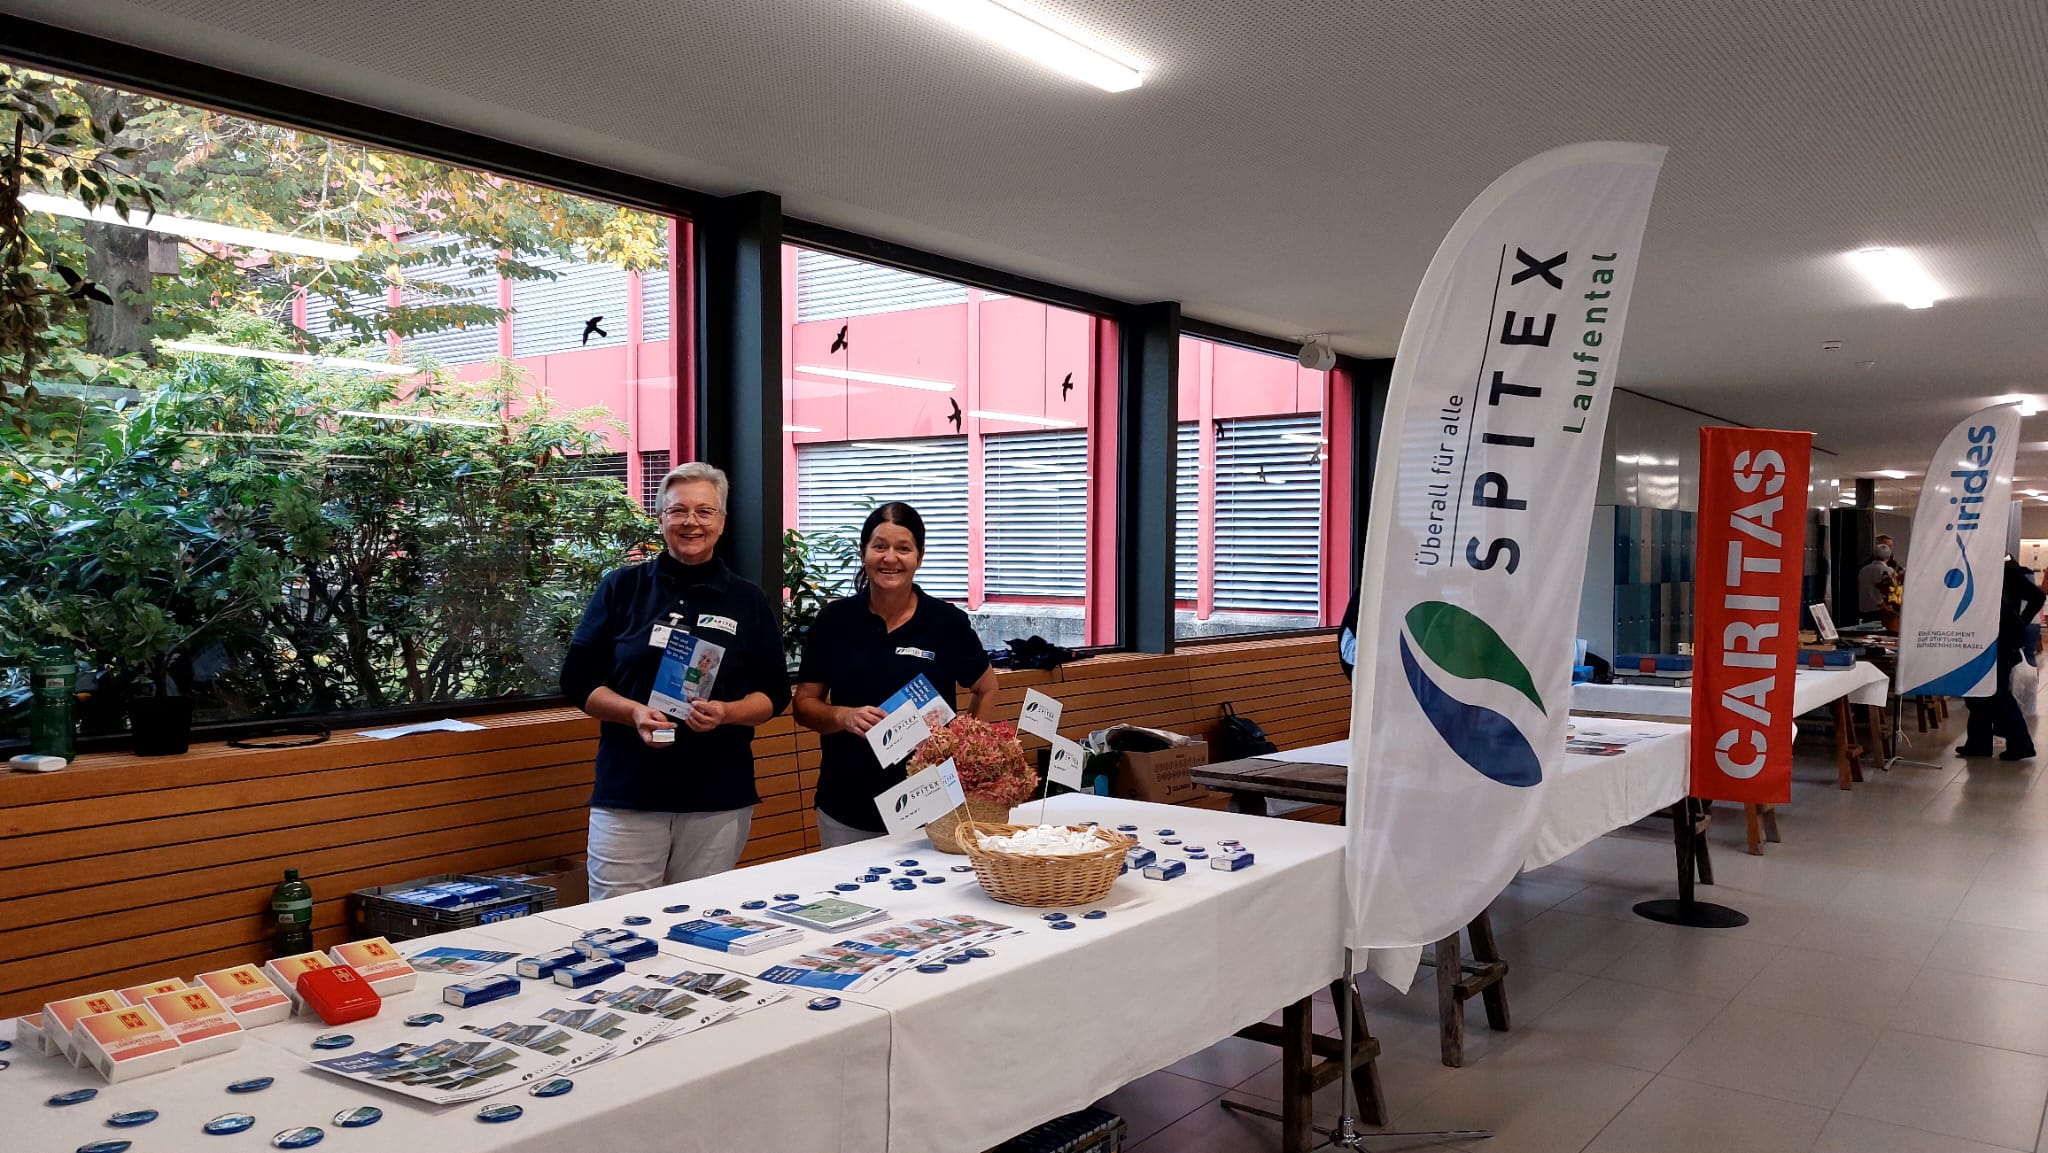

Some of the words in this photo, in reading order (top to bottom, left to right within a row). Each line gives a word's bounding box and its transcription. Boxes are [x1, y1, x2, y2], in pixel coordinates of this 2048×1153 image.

[1466, 247, 1568, 575] SPITEX
[1562, 252, 1617, 434] Laufental
[1415, 478, 1448, 566] Überall
[1432, 439, 1454, 476] für
[1443, 394, 1464, 436] alle
[1946, 424, 1996, 532] irides
[1714, 449, 1786, 779] CARITAS
[910, 781, 939, 800] SPITEX
